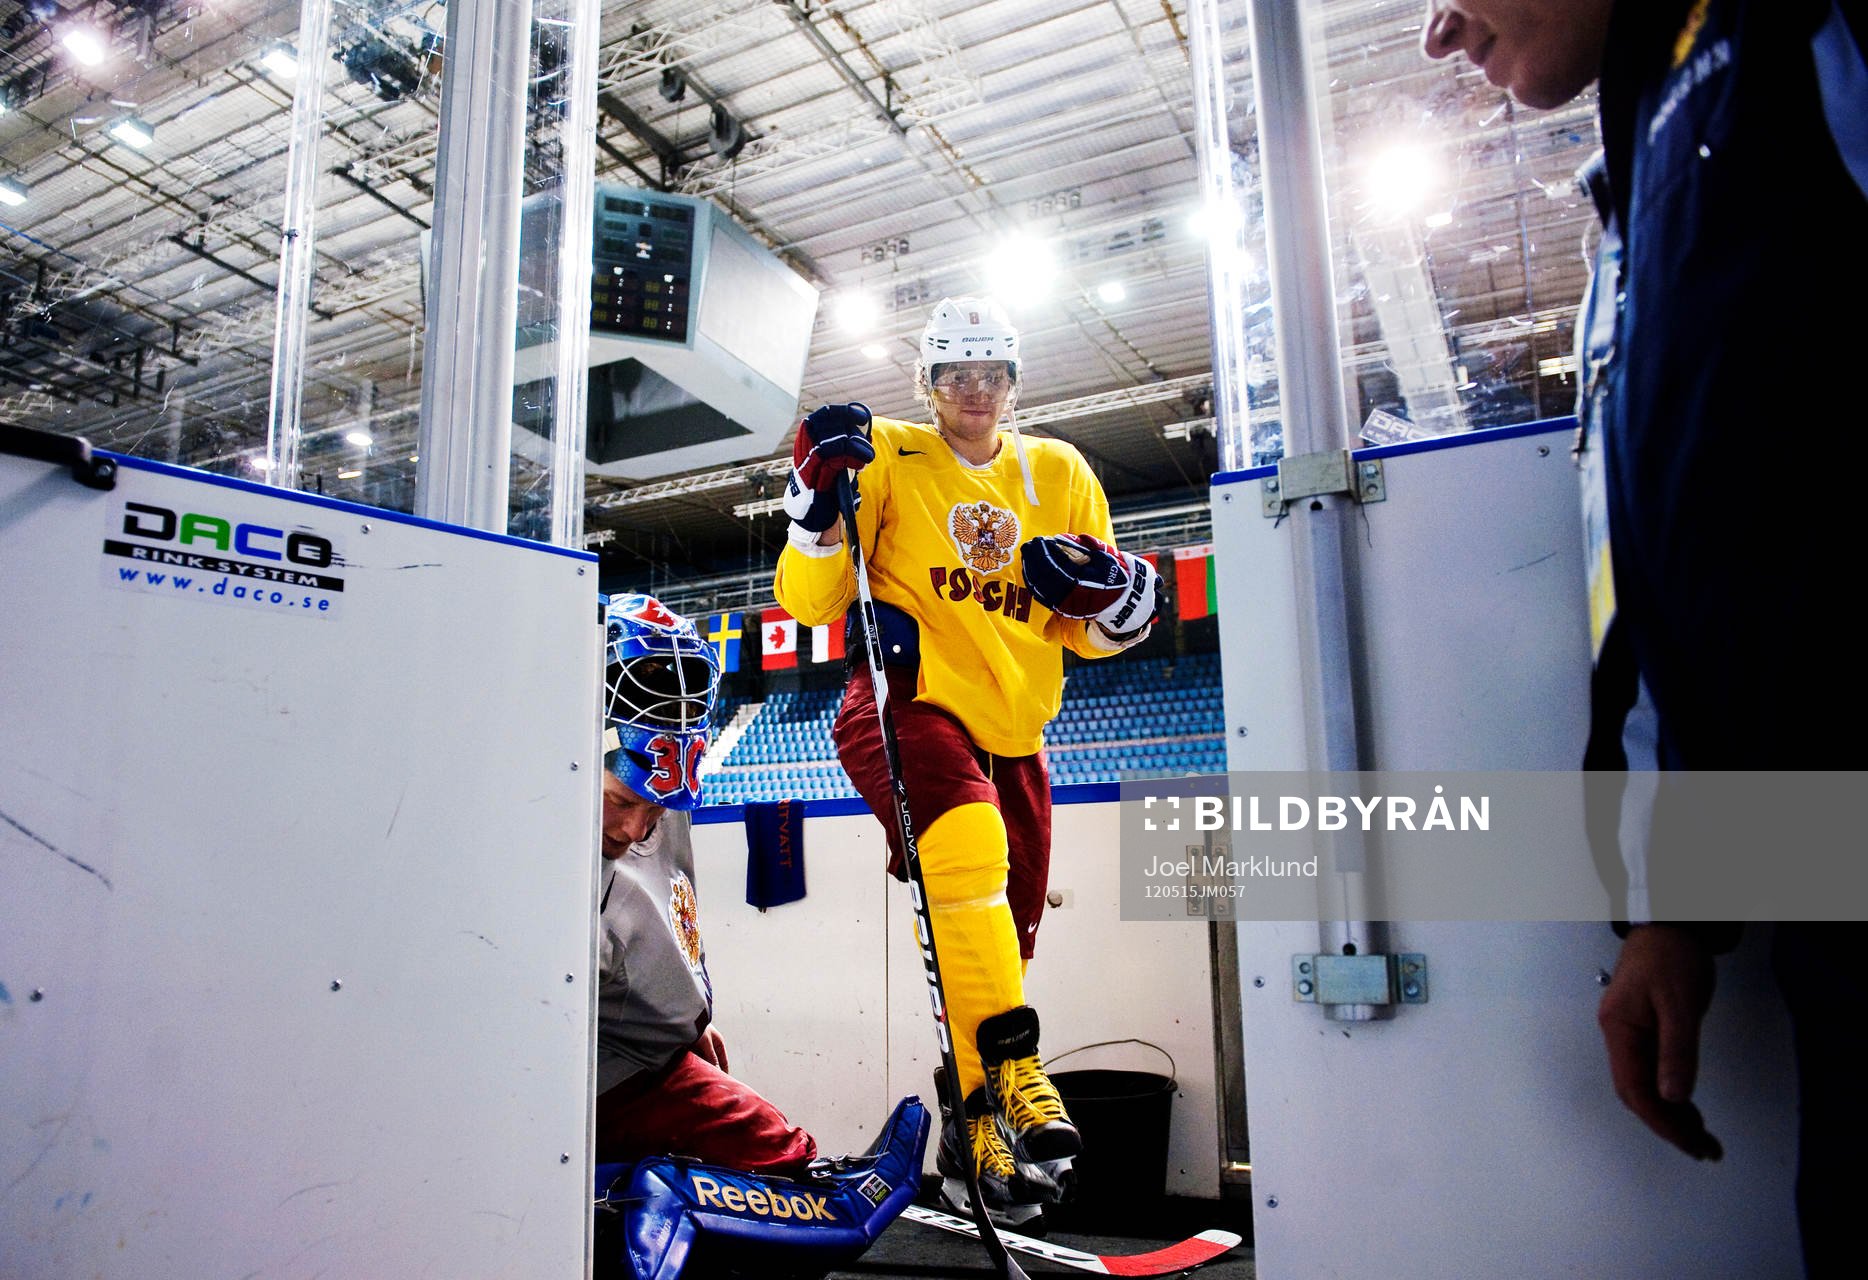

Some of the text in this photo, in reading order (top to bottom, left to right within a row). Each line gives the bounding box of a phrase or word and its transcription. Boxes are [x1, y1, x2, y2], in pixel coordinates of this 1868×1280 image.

[1373, 414, 1430, 441] DAC
[123, 502, 333, 568] DACO
[118, 567, 330, 611] www.daco.se
[132, 547, 319, 587] RINK-SYSTEM
[1107, 565, 1119, 584] GR8
[1109, 559, 1147, 629] BAUER
[901, 800, 917, 861] VAPOR
[691, 1175, 838, 1221] Reebok
